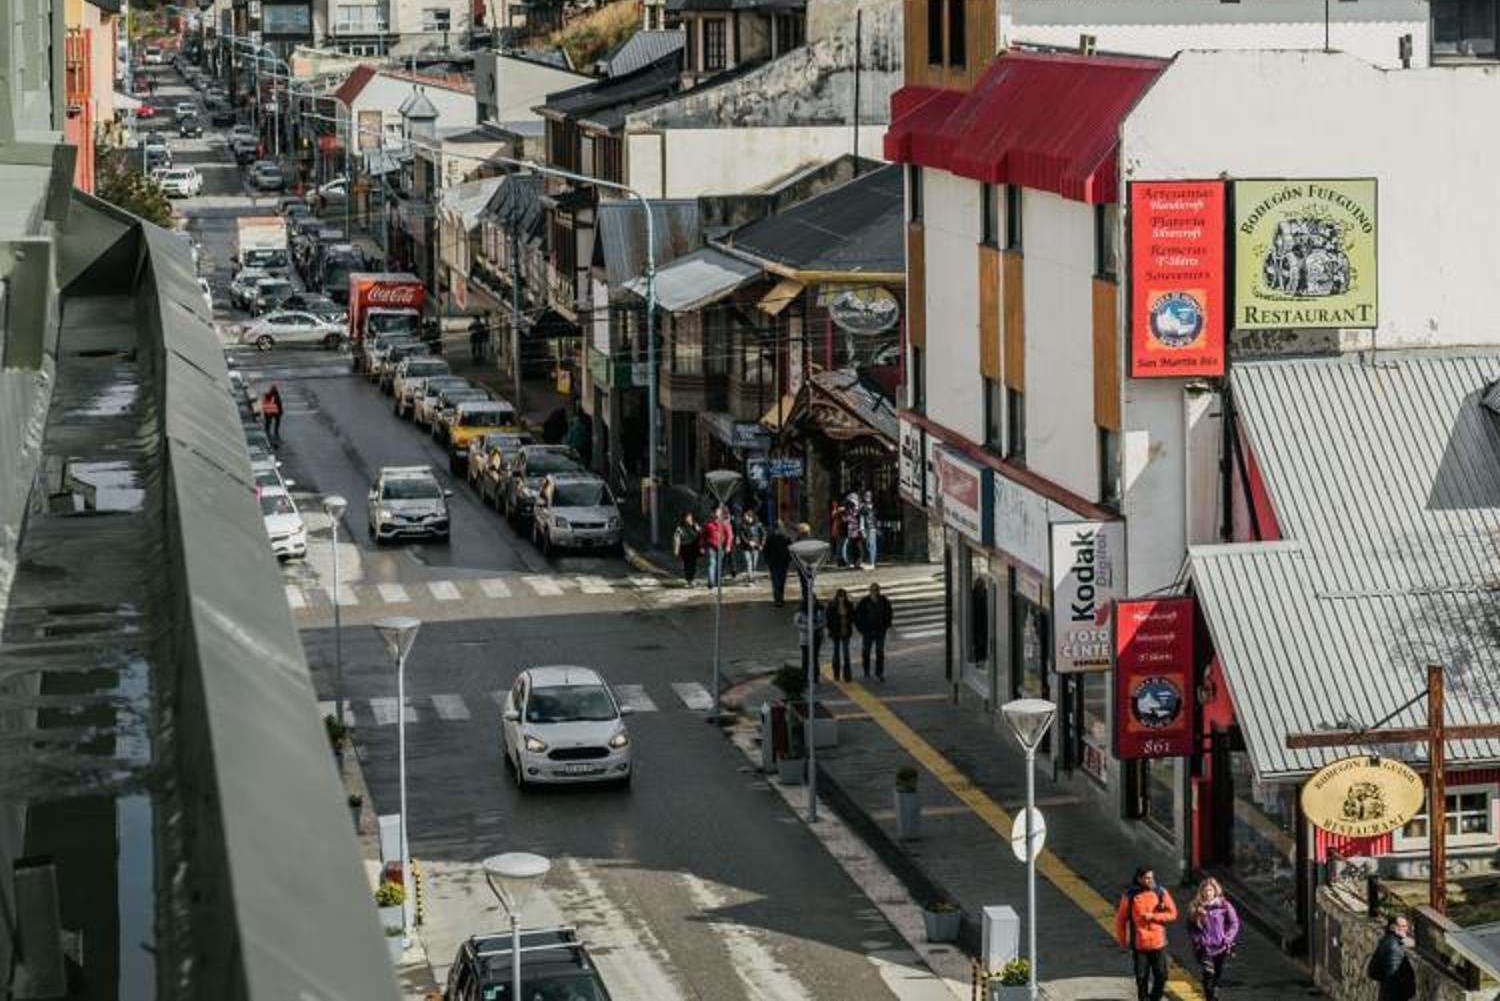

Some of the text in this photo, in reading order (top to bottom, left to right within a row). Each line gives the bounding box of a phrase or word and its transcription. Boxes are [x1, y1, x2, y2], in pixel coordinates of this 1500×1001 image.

[1307, 184, 1373, 234] FUEGUINO
[1244, 304, 1373, 324] RESTAURANT
[1070, 528, 1095, 622] Kodak
[1069, 630, 1109, 642] FOTO
[1063, 644, 1110, 658] CENTE
